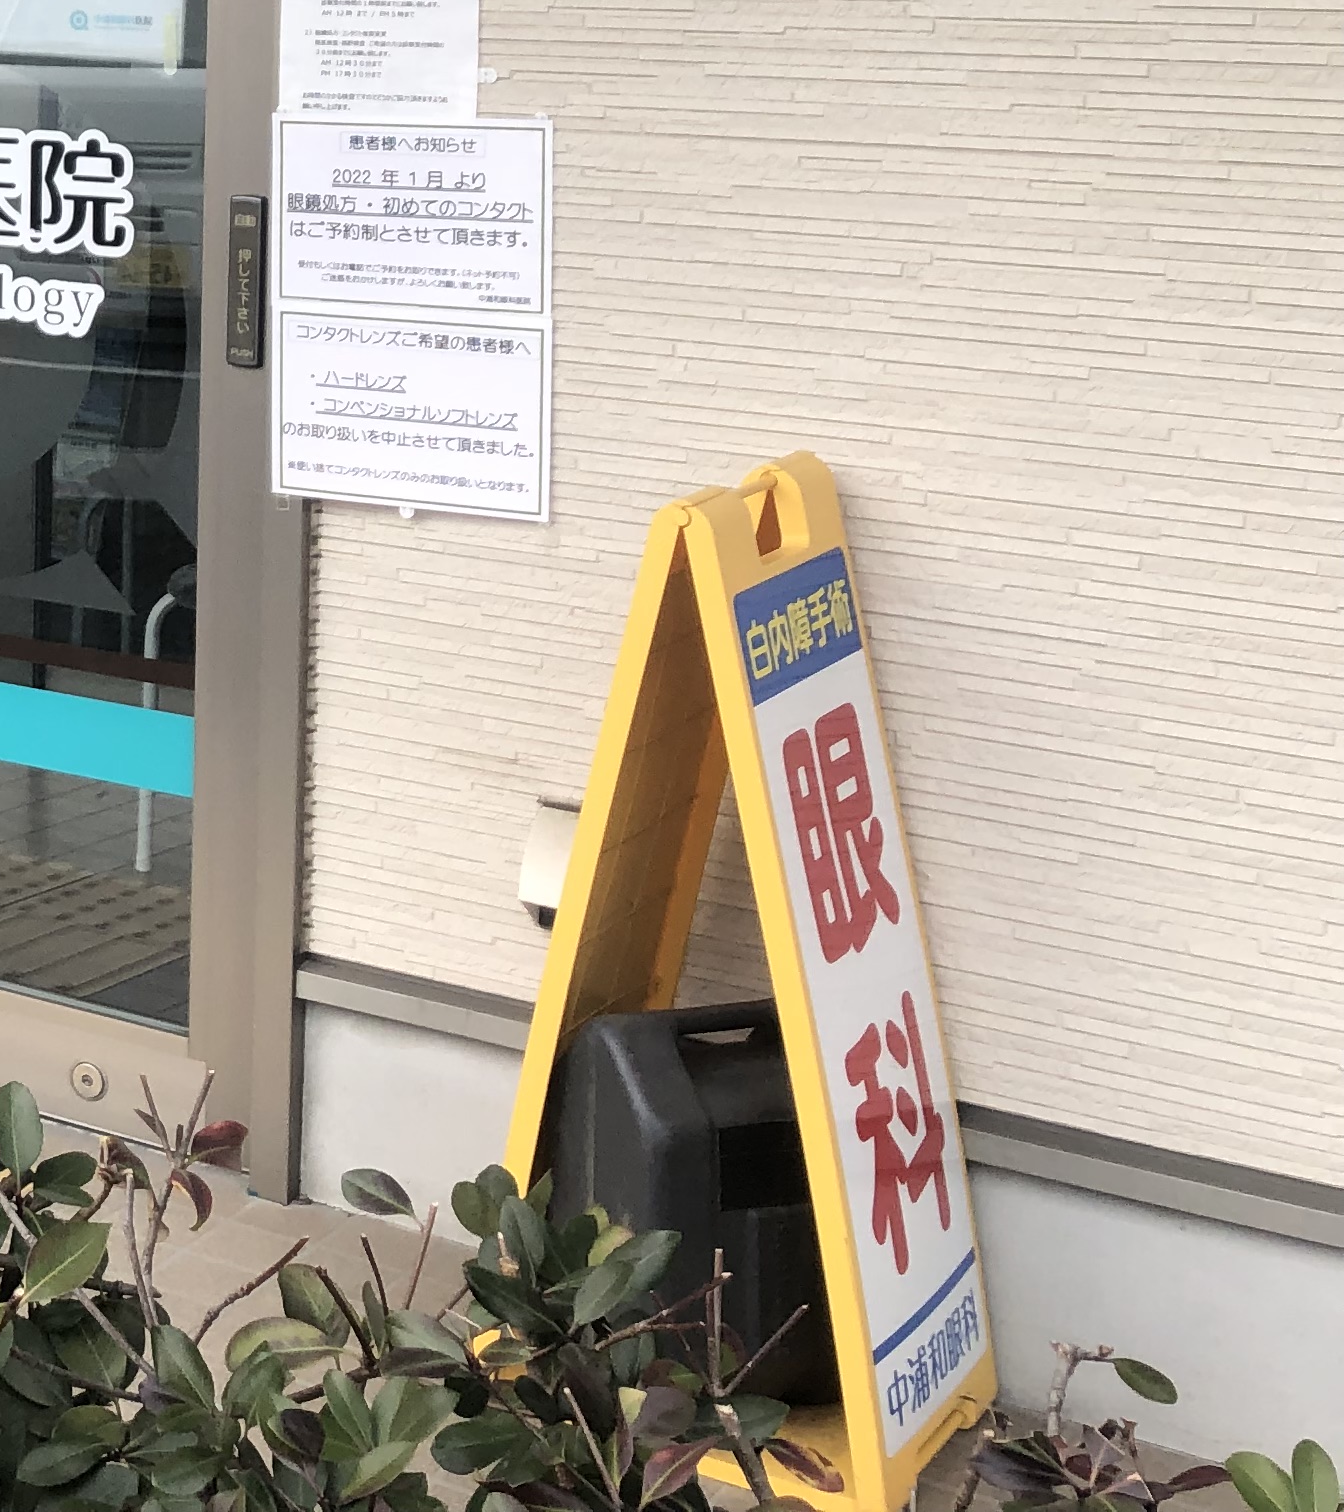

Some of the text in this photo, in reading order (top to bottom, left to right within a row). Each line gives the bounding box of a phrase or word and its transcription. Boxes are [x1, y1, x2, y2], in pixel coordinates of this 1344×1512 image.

[349, 135, 477, 154] 患者様へお知らせ
[332, 168, 486, 190] 2022 年 1 月 より
[290, 220, 528, 248] はご予約制とさせて頂きます。
[296, 325, 531, 355] コンタクトレンズご希望の患者様へ
[283, 422, 534, 458] のお取り扱いを中止させて頂きました。
[746, 579, 854, 682] 白内障手術
[783, 701, 951, 1276] 眼科
[887, 1288, 980, 1426] 中浦和眼科
